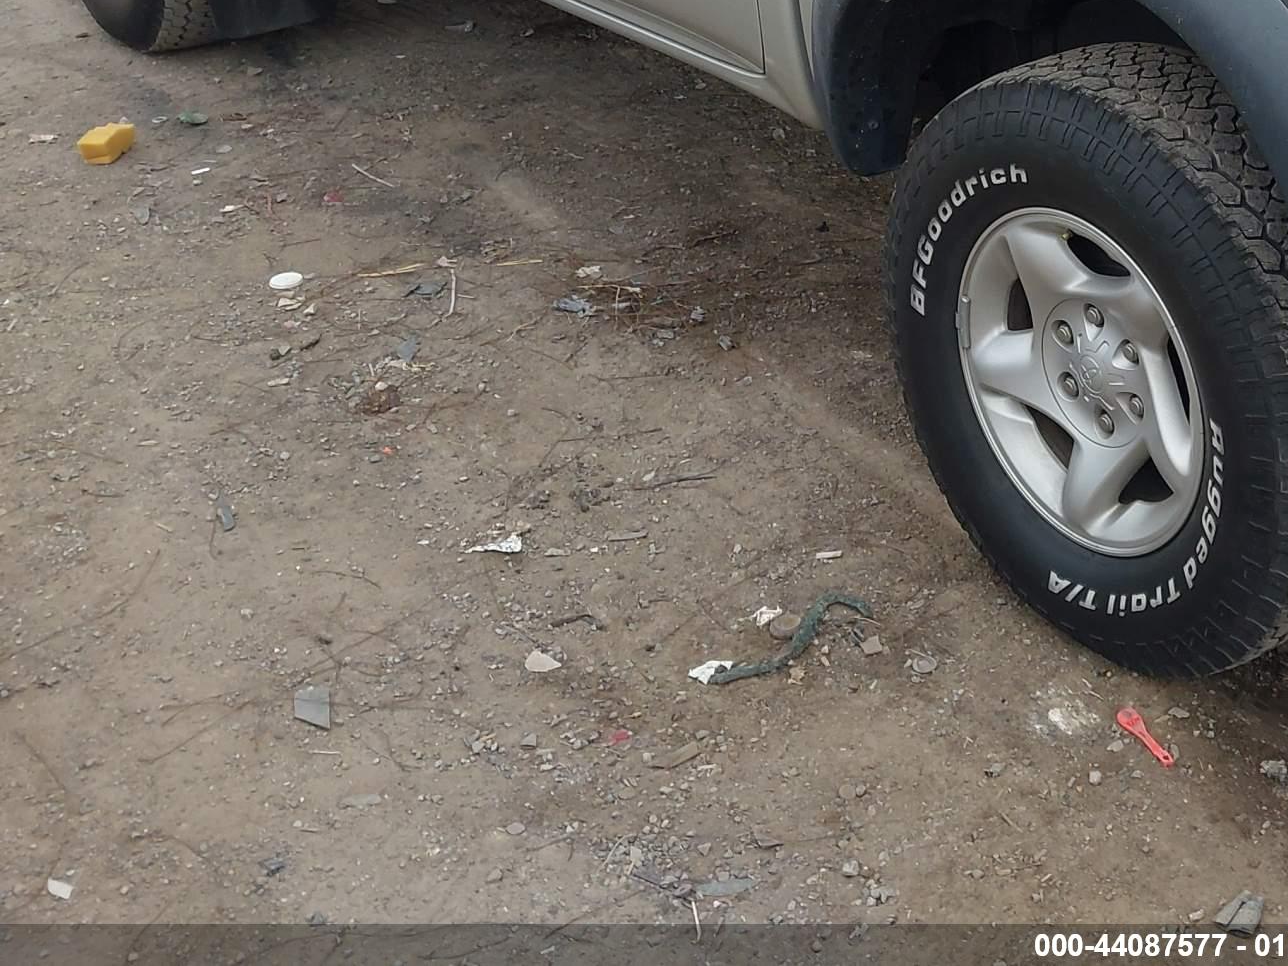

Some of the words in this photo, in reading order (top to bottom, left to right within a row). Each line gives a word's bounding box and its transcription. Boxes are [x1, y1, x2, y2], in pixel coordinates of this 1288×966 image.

[910, 163, 1028, 316] BFGoodrich
[1182, 418, 1225, 589] Rugged
[1047, 569, 1097, 611] T/A
[1106, 576, 1182, 617] Trail
